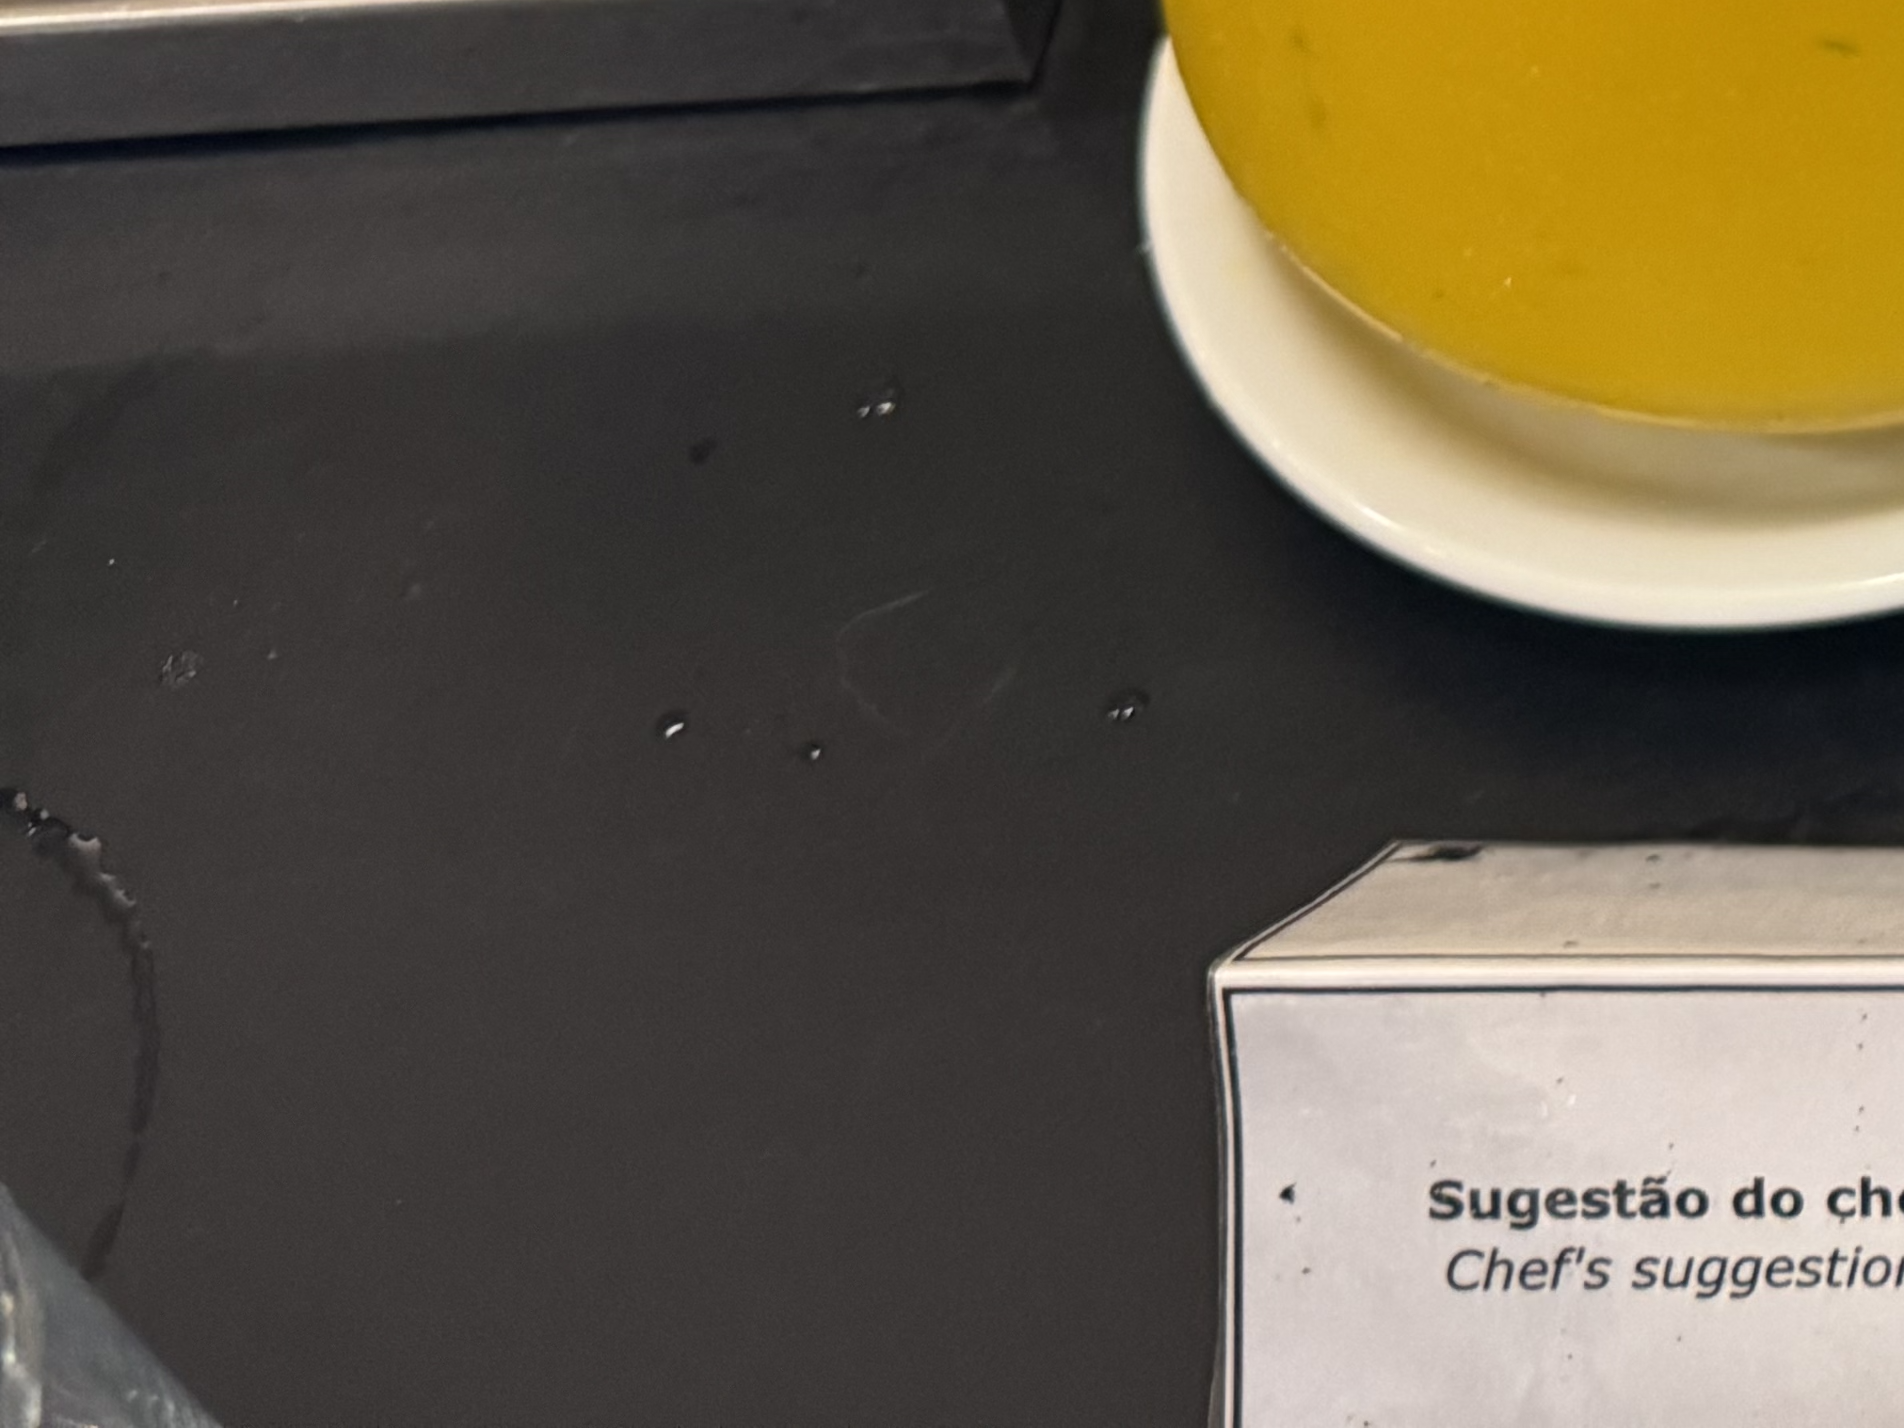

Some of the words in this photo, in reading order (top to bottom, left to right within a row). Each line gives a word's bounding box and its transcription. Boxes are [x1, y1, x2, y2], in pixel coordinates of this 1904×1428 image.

[1427, 1176, 1710, 1230] Sugestão
[1731, 1176, 1804, 1219] do
[1445, 1245, 1612, 1292] Chef's
